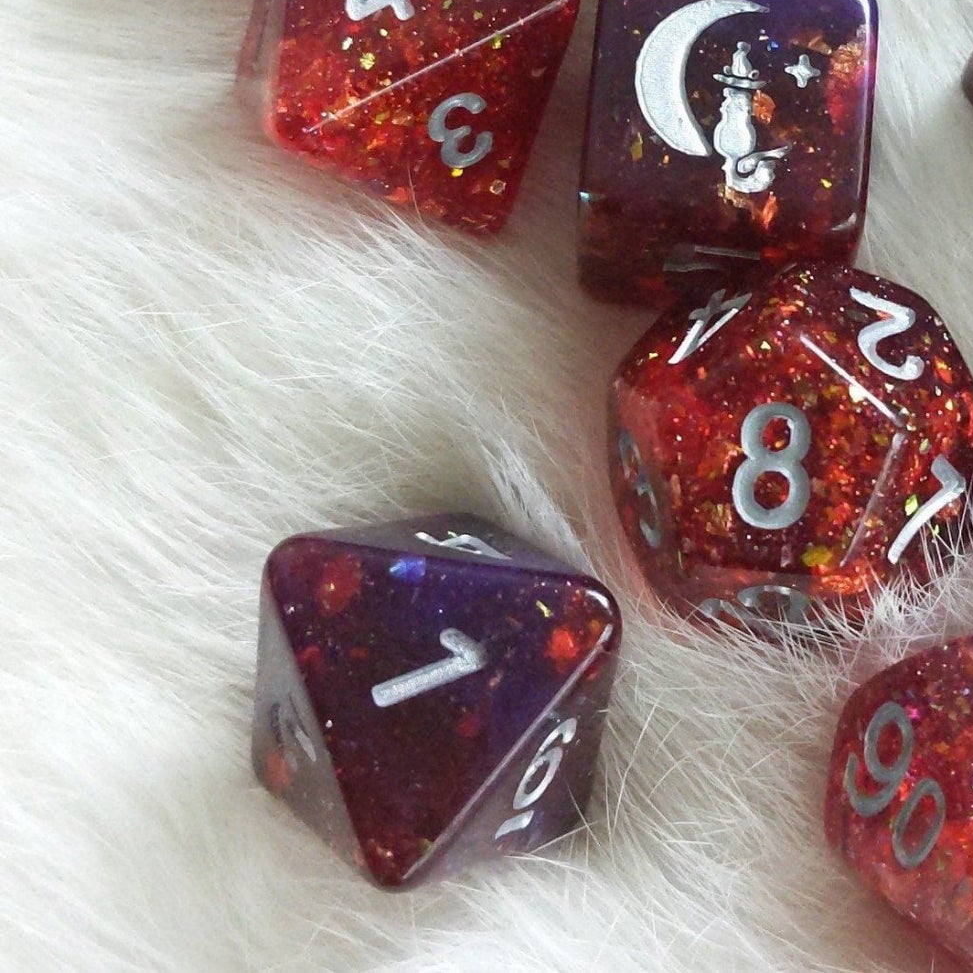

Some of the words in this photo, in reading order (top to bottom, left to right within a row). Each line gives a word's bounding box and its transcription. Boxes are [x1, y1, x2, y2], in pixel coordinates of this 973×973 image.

[427, 91, 494, 169] 3
[848, 283, 926, 381] 2
[731, 401, 812, 530] 8
[842, 701, 947, 869] 90
